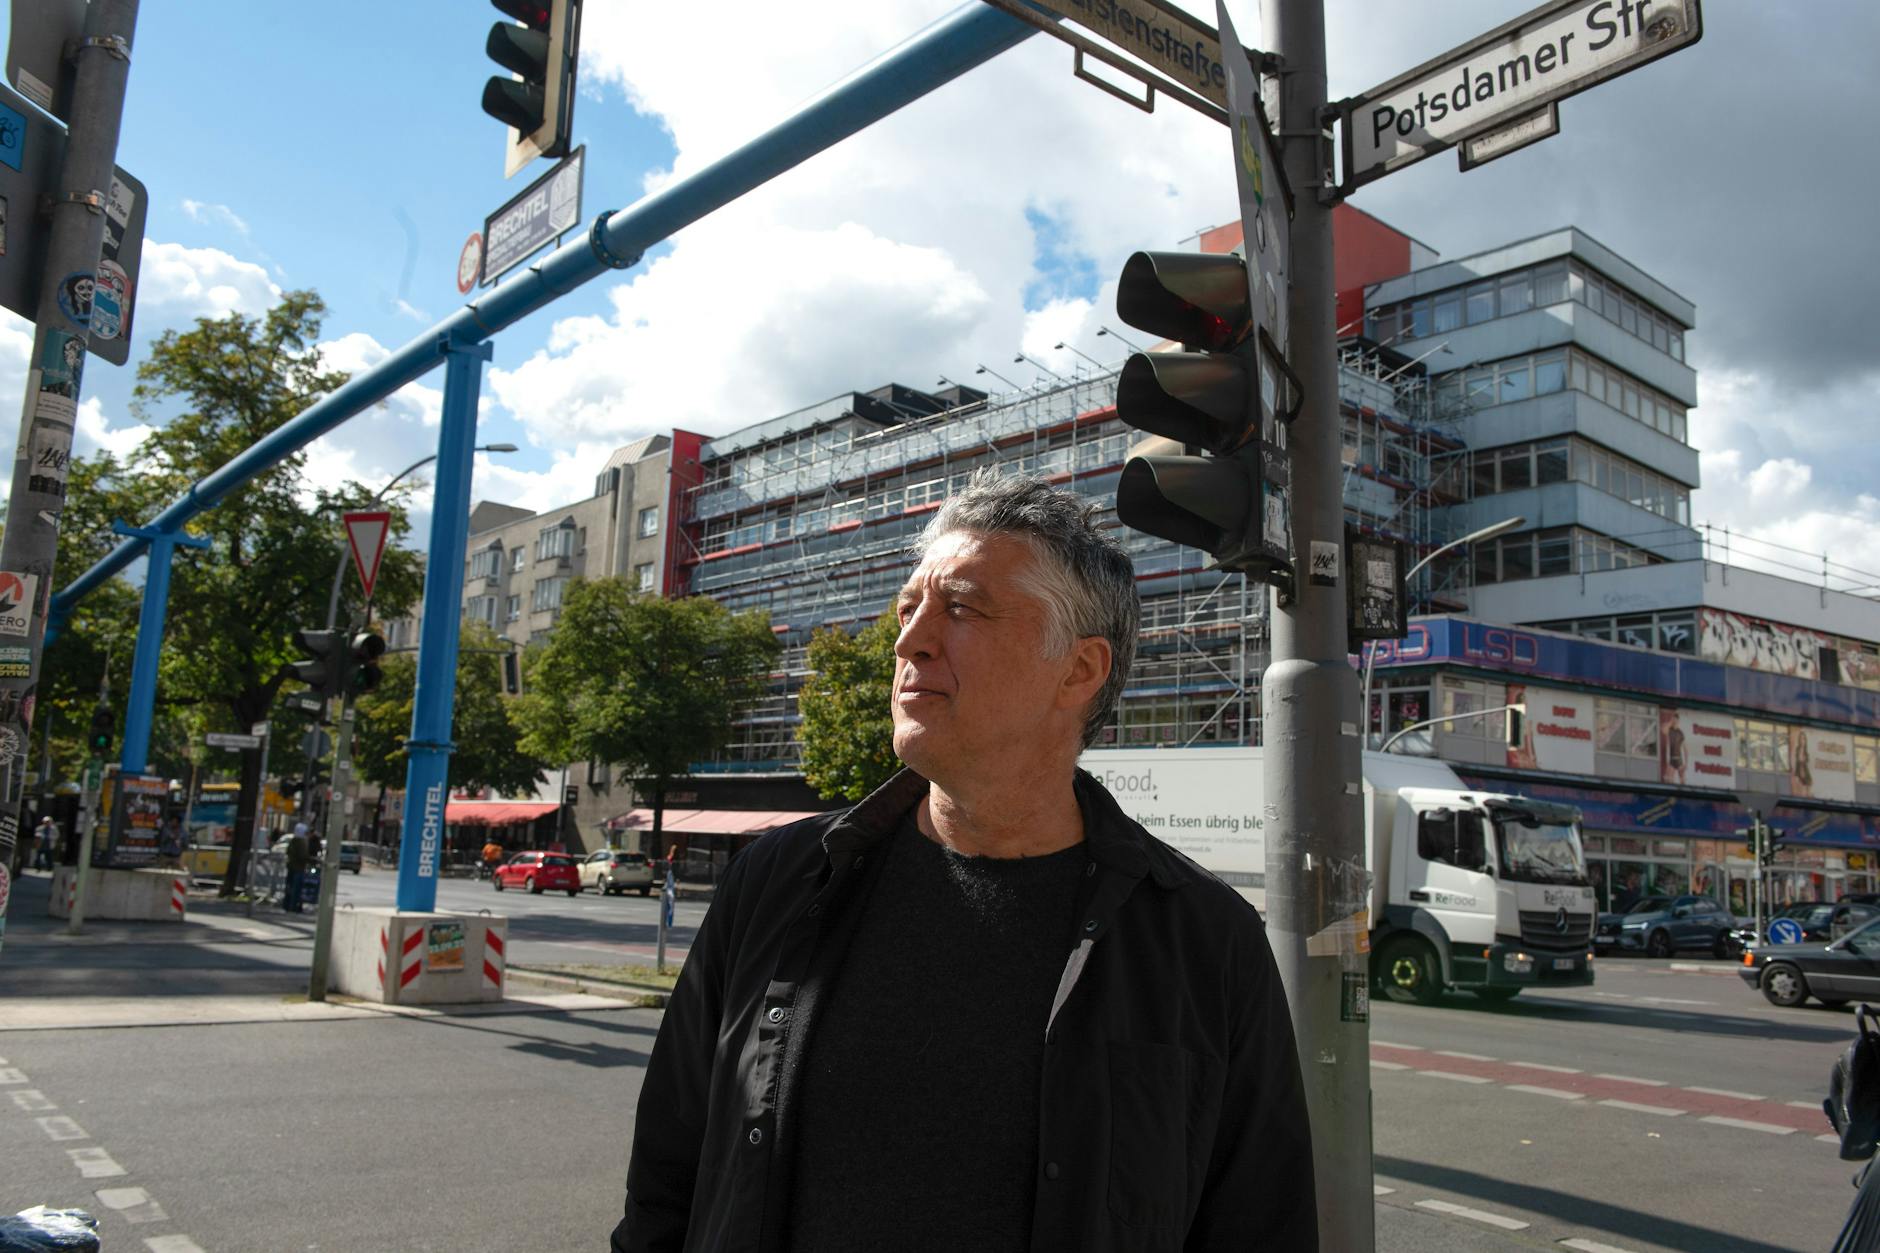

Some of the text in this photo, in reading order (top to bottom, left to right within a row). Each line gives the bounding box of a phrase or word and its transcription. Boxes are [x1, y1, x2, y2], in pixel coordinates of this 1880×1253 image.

[1373, 31, 1575, 149] Potsdamer
[488, 190, 548, 249] BRECHTEL
[1464, 624, 1538, 666] LSD
[1087, 767, 1152, 792] Food
[418, 781, 442, 878] BRECHTEL
[1136, 812, 1166, 828] beim
[1169, 814, 1202, 828] Essen
[1206, 815, 1240, 833] übrig
[1435, 892, 1477, 907] ReFood
